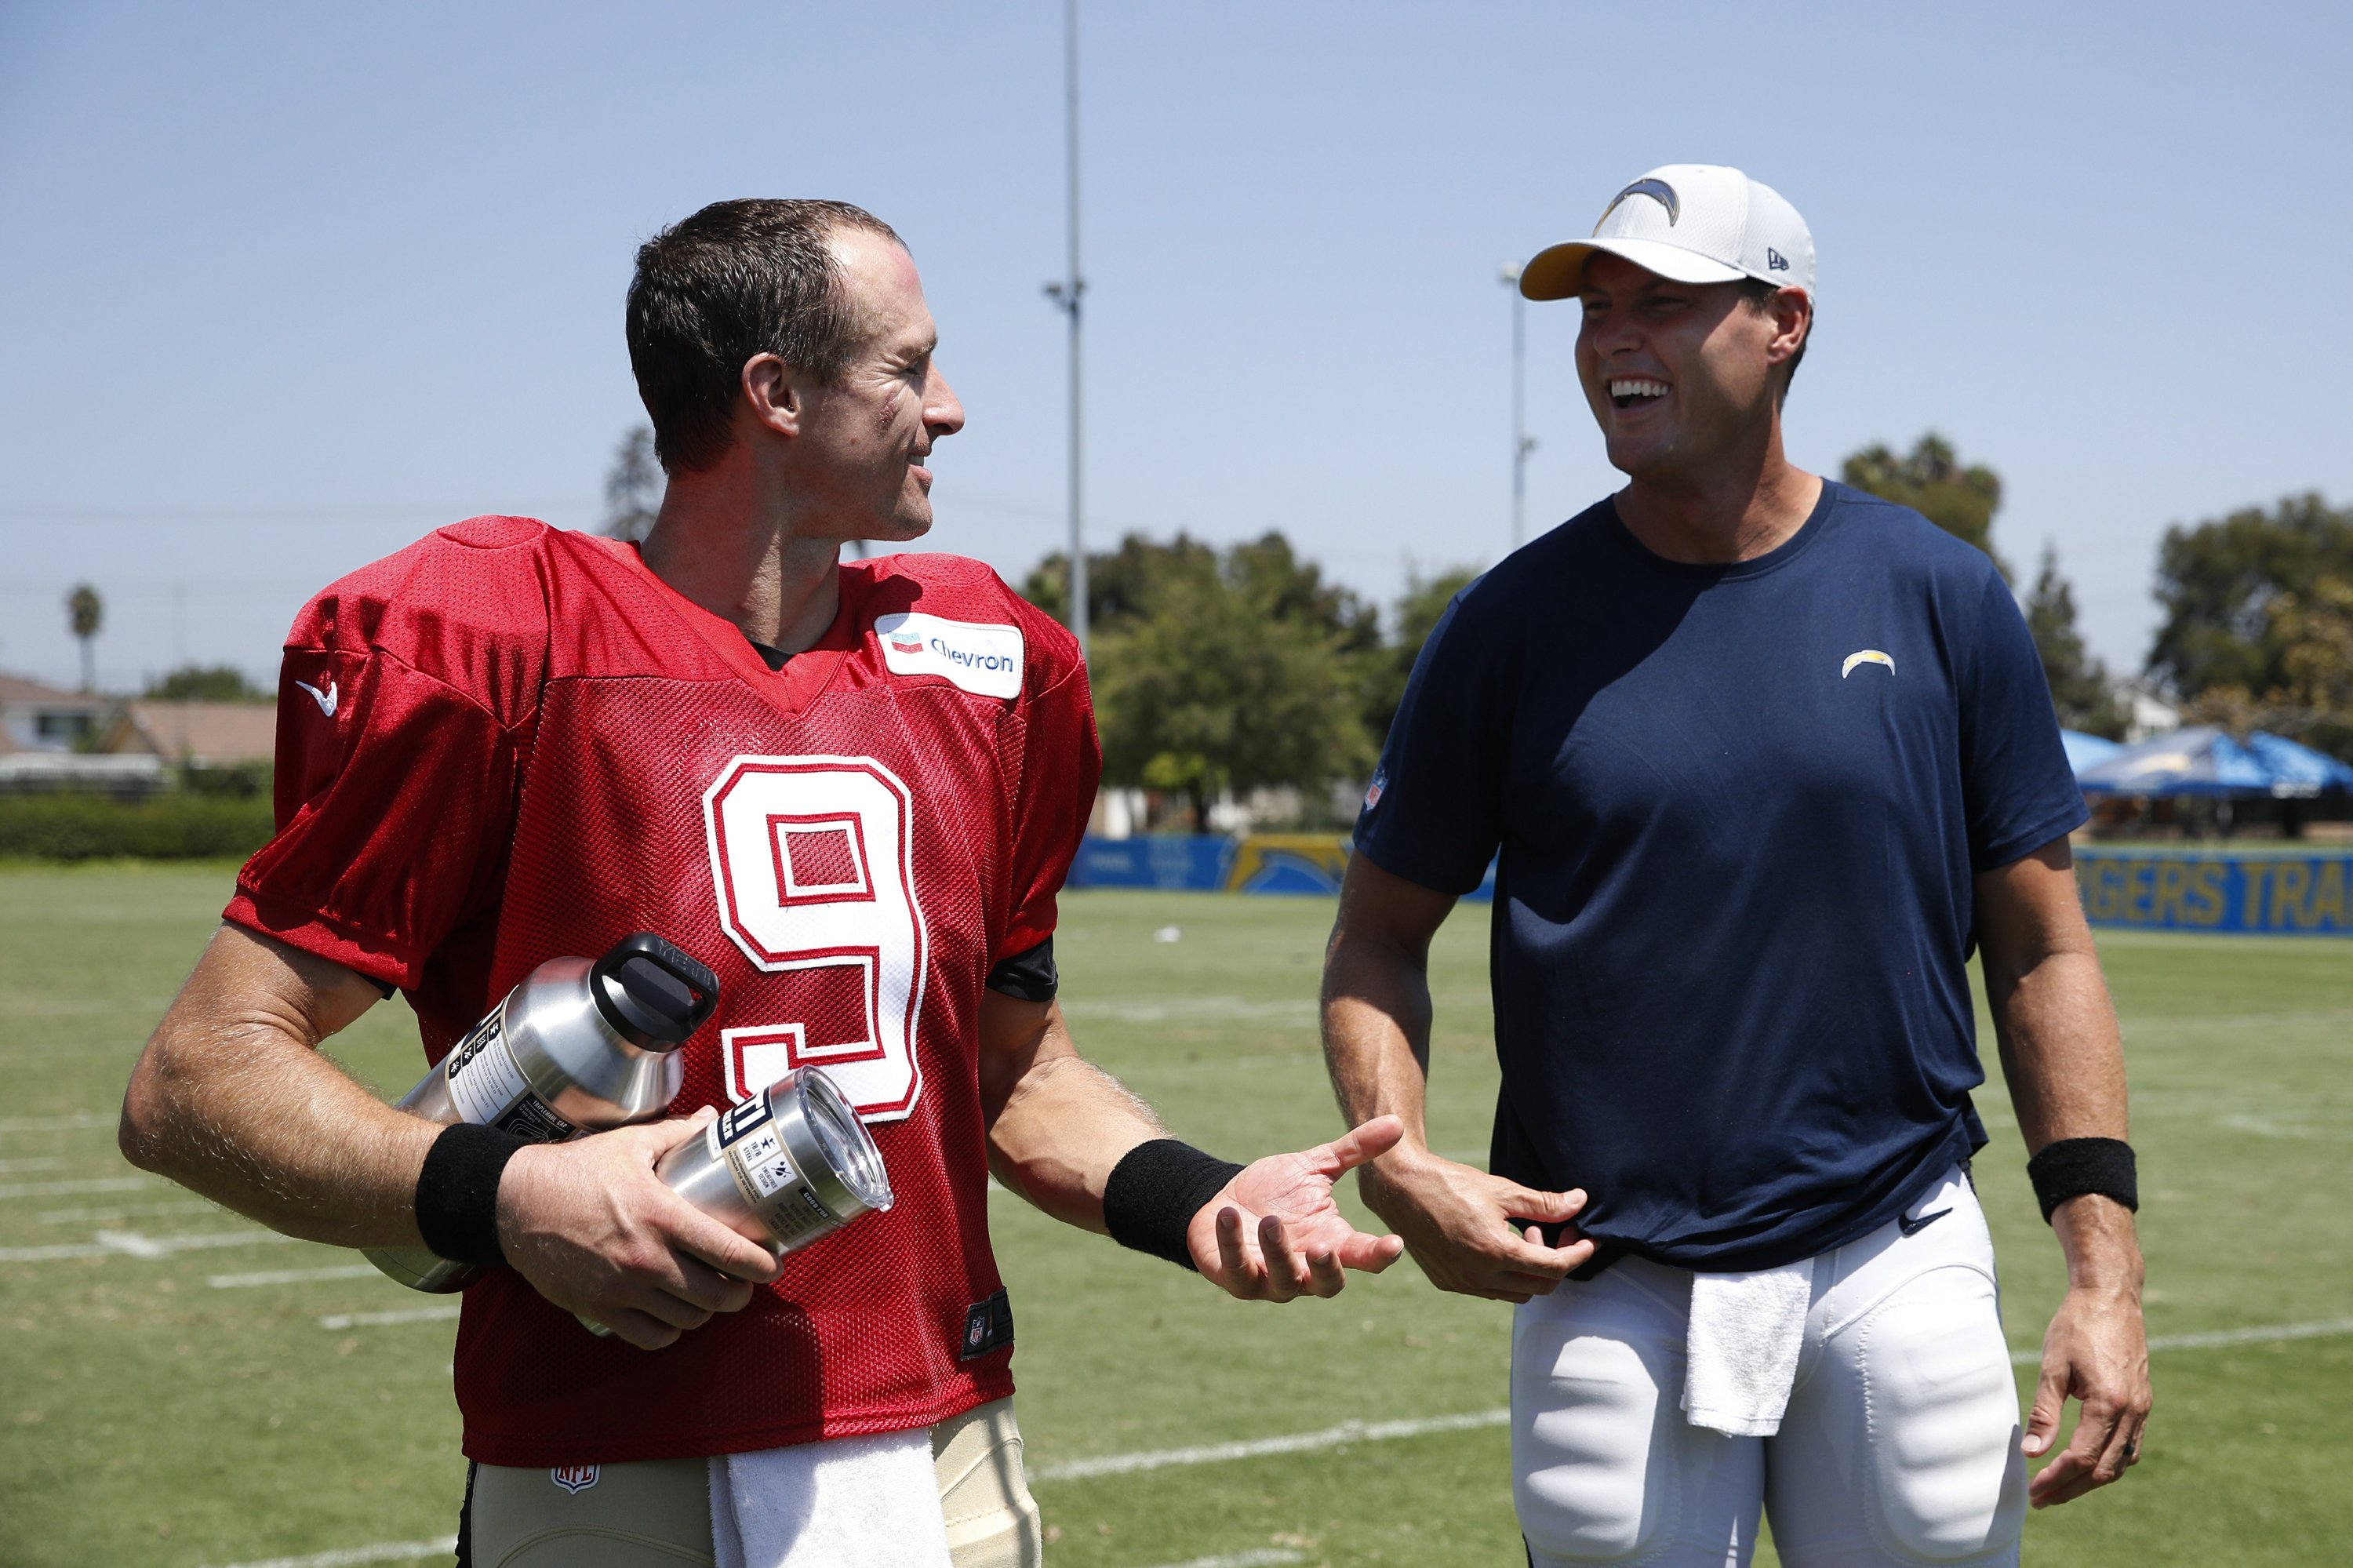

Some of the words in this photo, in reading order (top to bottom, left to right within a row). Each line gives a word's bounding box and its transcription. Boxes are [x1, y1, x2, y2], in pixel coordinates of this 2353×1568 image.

[930, 638, 1013, 672] Chevron
[2075, 860, 2228, 924] GERS
[2241, 862, 2353, 926] TRA
[703, 754, 929, 1123] 9
[533, 1100, 557, 1122] TRIPLEHAUL
[734, 1090, 766, 1132] TI
[743, 1147, 753, 1163] STEEL
[751, 1141, 762, 1158] 18/8
[758, 1173, 770, 1189] DESIGN
[802, 1191, 819, 1209] GOOD
[816, 1206, 828, 1218] FOR
[558, 1464, 593, 1484] NFL
